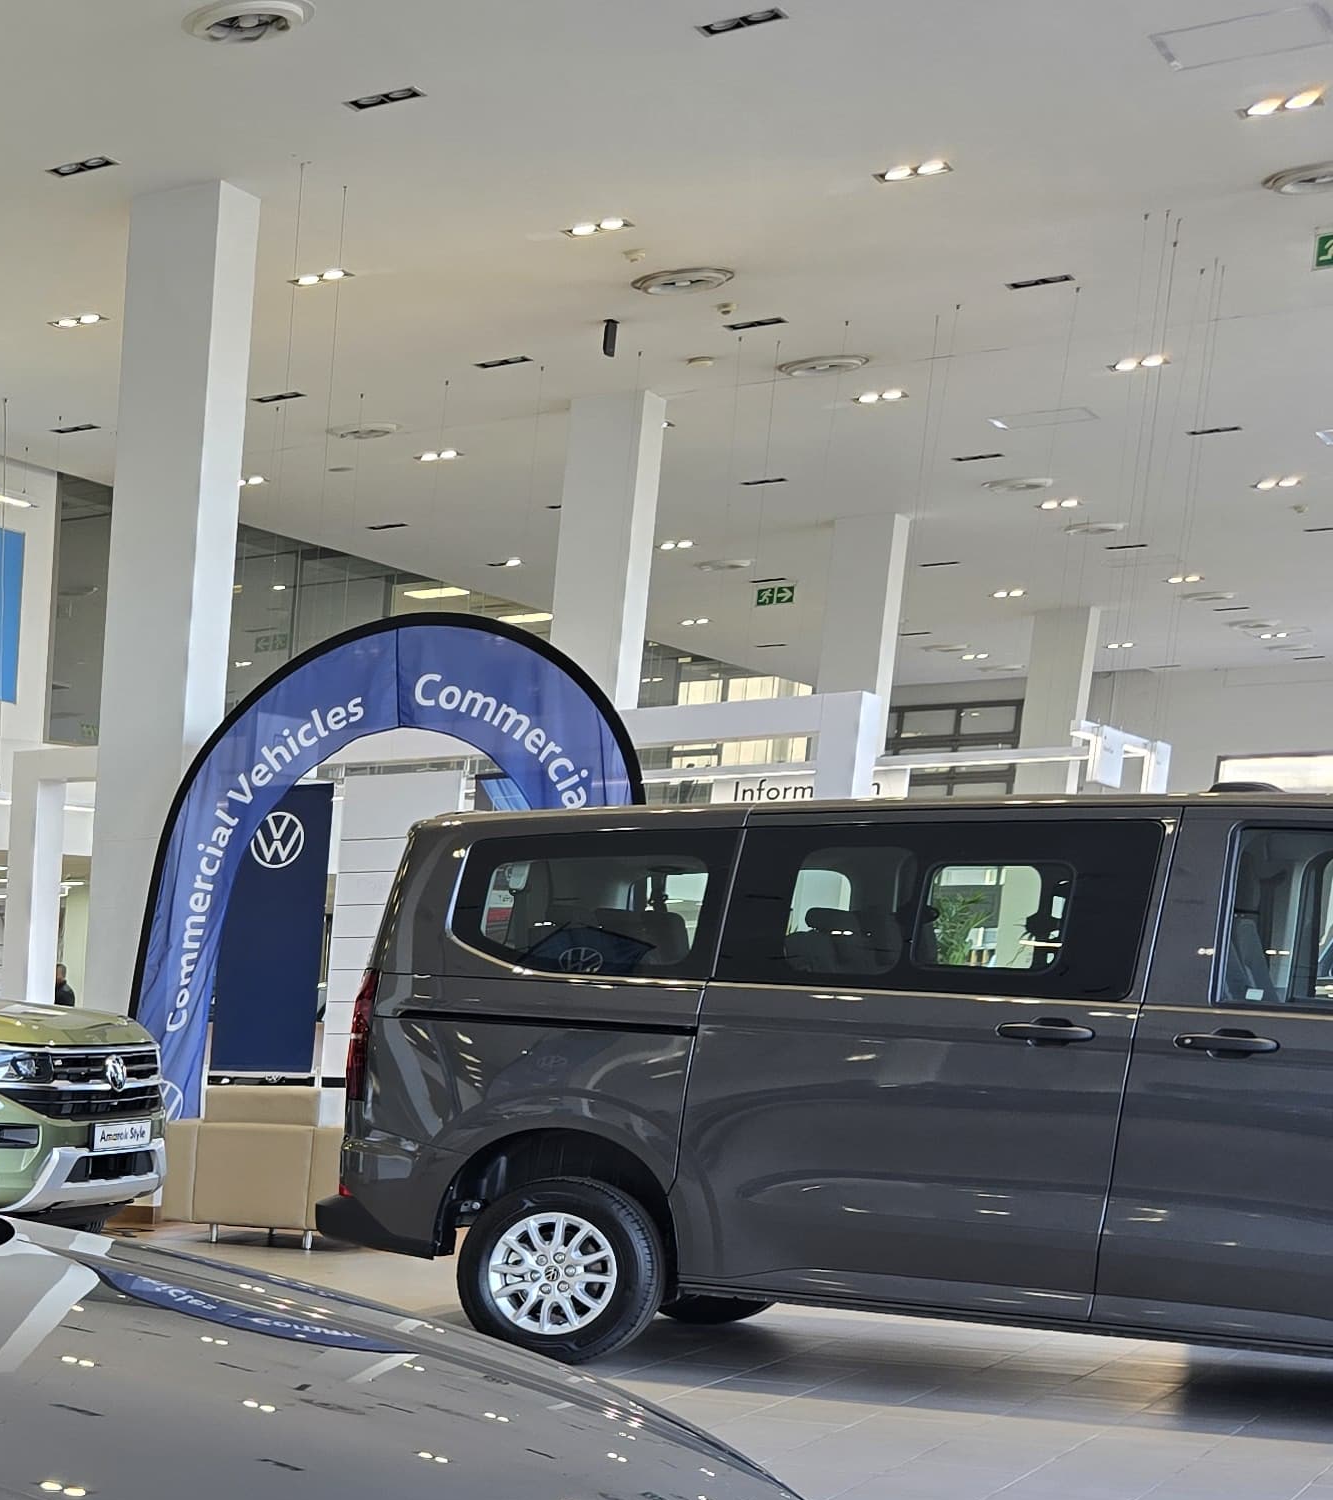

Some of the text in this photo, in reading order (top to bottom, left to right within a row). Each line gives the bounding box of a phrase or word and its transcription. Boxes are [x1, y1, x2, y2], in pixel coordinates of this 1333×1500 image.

[414, 673, 589, 809] Commercia
[166, 696, 365, 1033] Commercial Vehicles
[130, 1125, 146, 1141] Style
